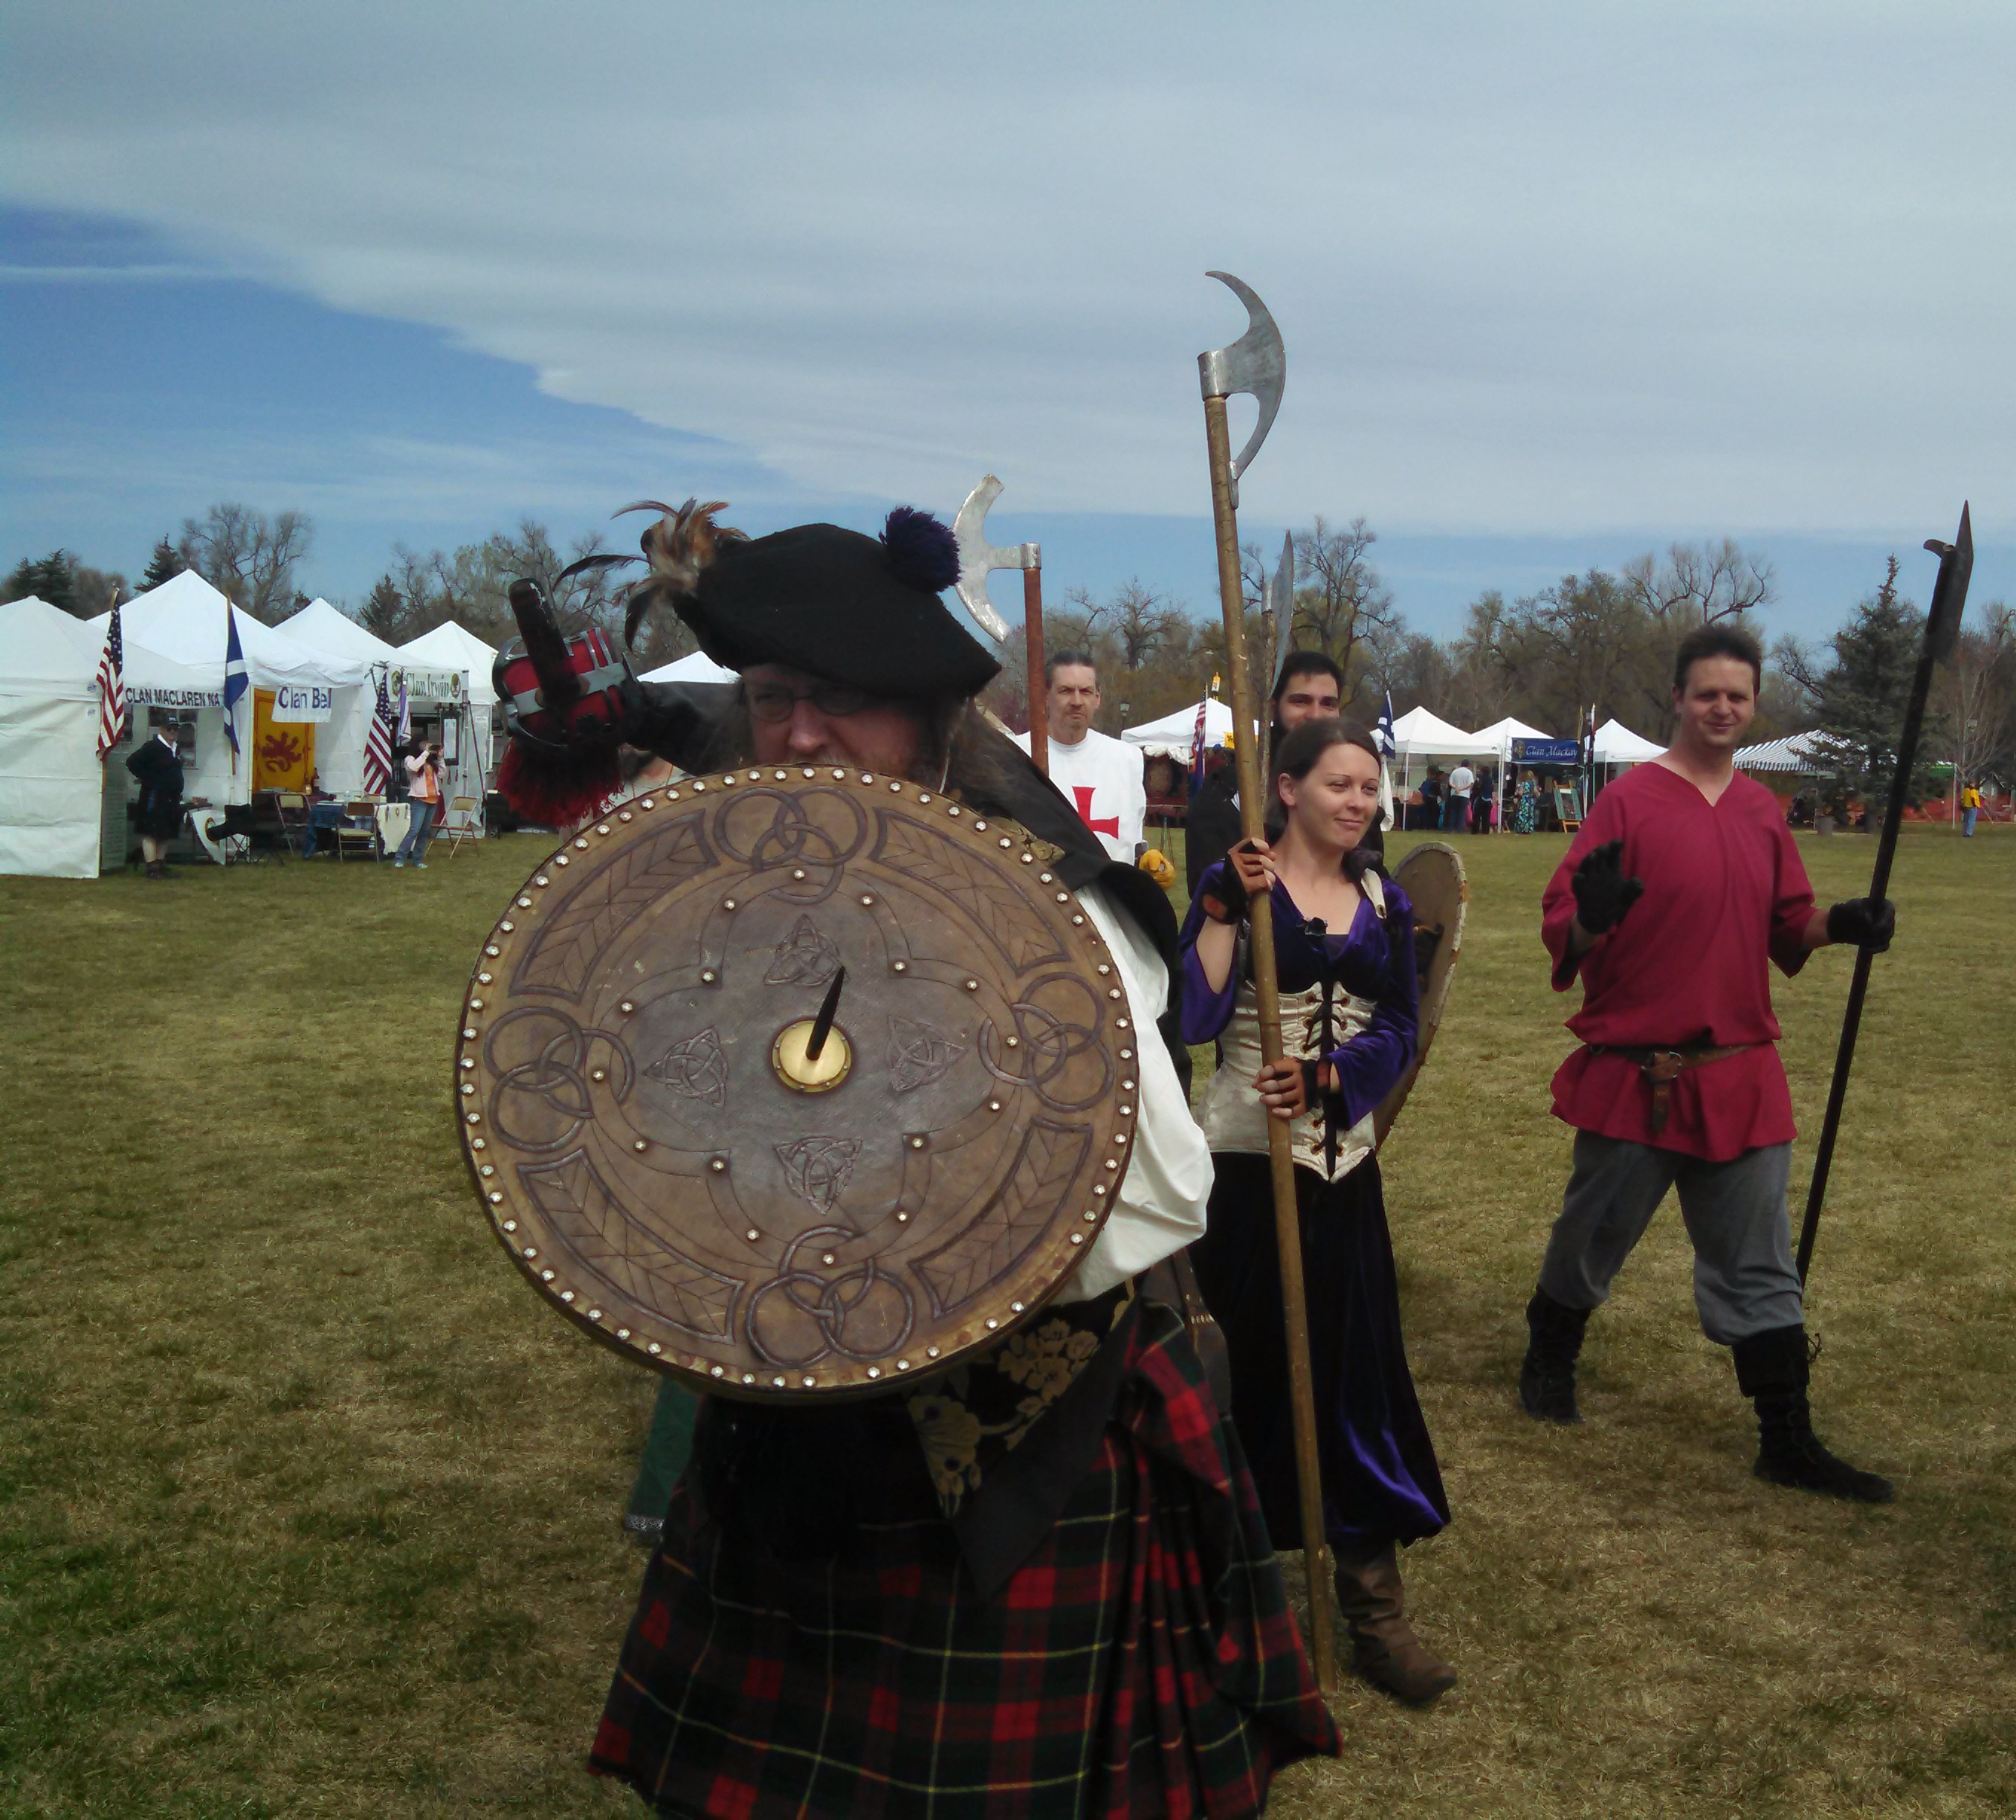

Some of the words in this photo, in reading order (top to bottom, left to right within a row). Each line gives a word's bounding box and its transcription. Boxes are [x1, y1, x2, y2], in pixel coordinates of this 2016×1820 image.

[407, 673, 427, 696] Clan
[126, 688, 152, 703] CLAN
[154, 688, 205, 706] MACLAREN
[278, 686, 307, 709] Clan
[1526, 746, 1544, 756] Clan
[1546, 746, 1577, 758] Mackay
